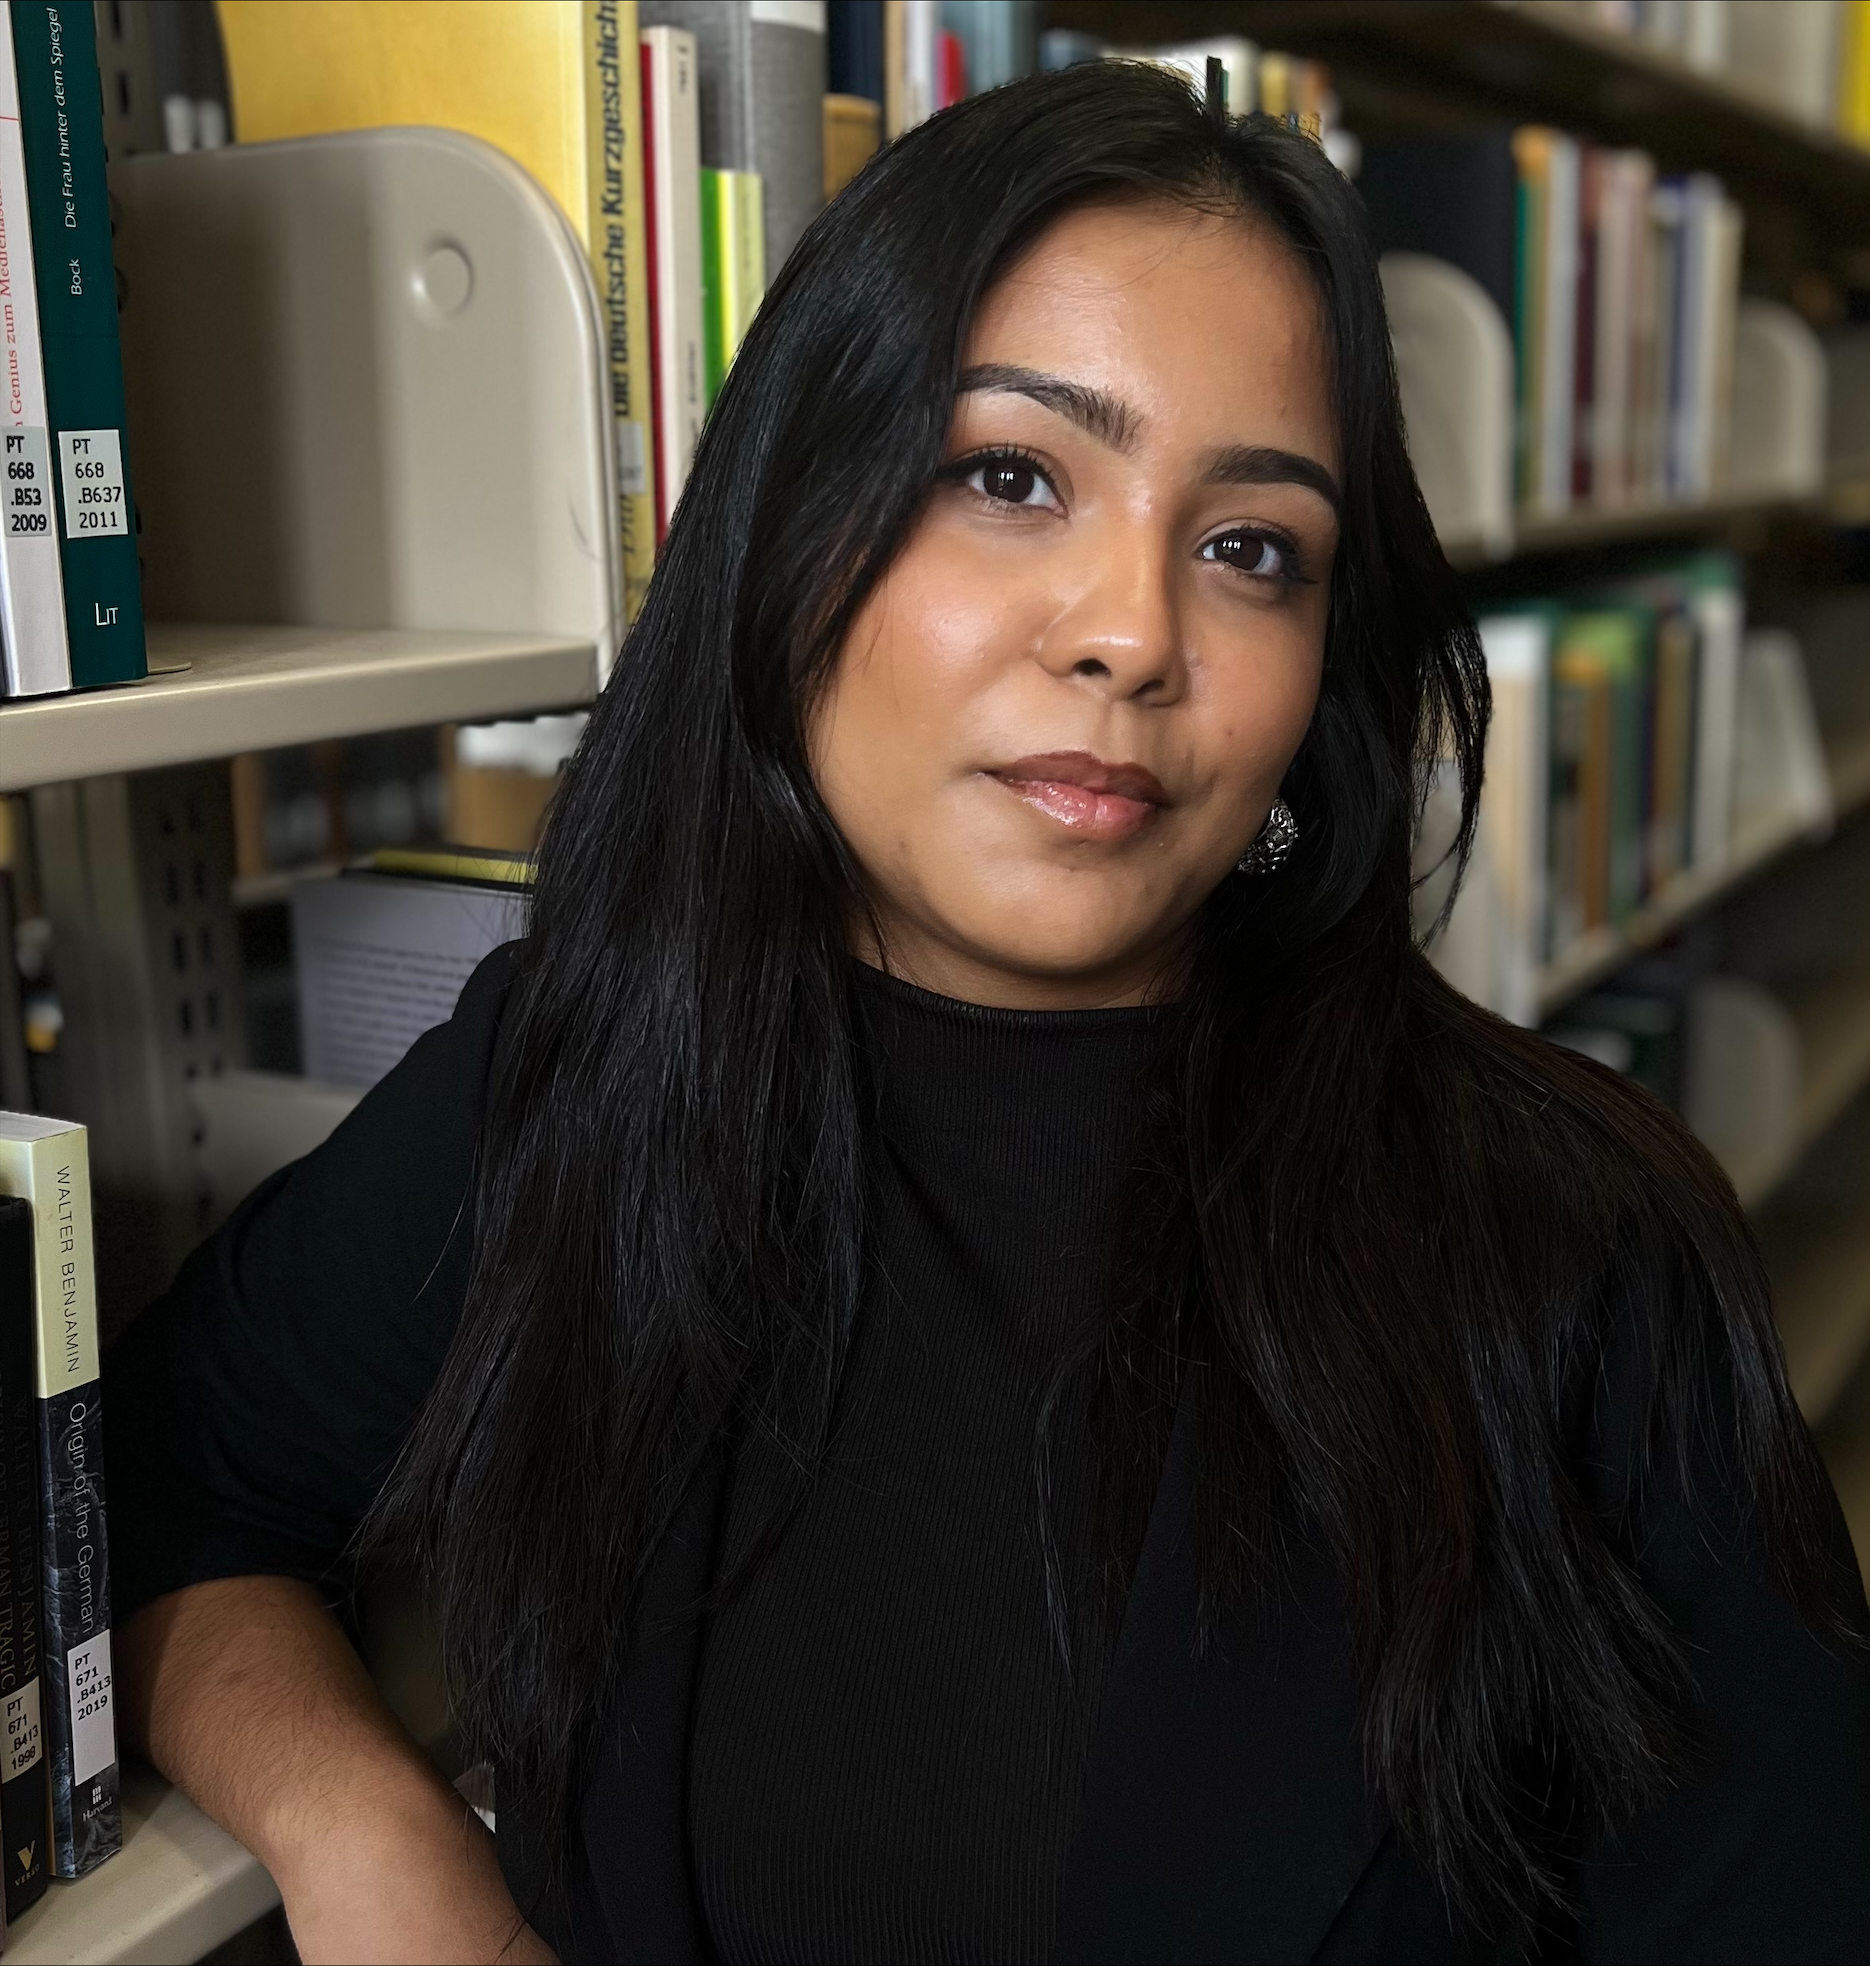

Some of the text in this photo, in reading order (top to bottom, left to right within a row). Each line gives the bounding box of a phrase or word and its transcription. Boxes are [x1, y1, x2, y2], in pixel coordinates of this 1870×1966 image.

[46, 7, 76, 228] Die Frau hinter dem Spiegel
[69, 258, 82, 295] Bock
[4, 304, 16, 344] zum
[8, 350, 23, 415] Genius
[6, 435, 25, 453] PT
[72, 439, 91, 454] PT
[8, 462, 34, 479] 668
[75, 462, 105, 478] 668
[11, 488, 42, 506] .B53
[78, 487, 121, 504] .B637
[11, 514, 47, 531] 2009
[79, 511, 118, 529] 2011
[57, 1165, 80, 1373] WALTER BENJAMIN
[67, 1402, 94, 1634] Origin of the German
[17, 1527, 37, 1676] BENJAMIN
[0, 1602, 16, 1690] TRAGIC
[75, 1652, 90, 1670] PT
[76, 1666, 98, 1687] 671
[77, 1675, 111, 1704] .B413
[7, 1696, 23, 1717] PT
[78, 1695, 107, 1721] 2019
[8, 1714, 27, 1735] 671
[10, 1724, 39, 1754] .B413
[82, 1797, 112, 1822] Harvard
[15, 1863, 40, 1887] VERSO
